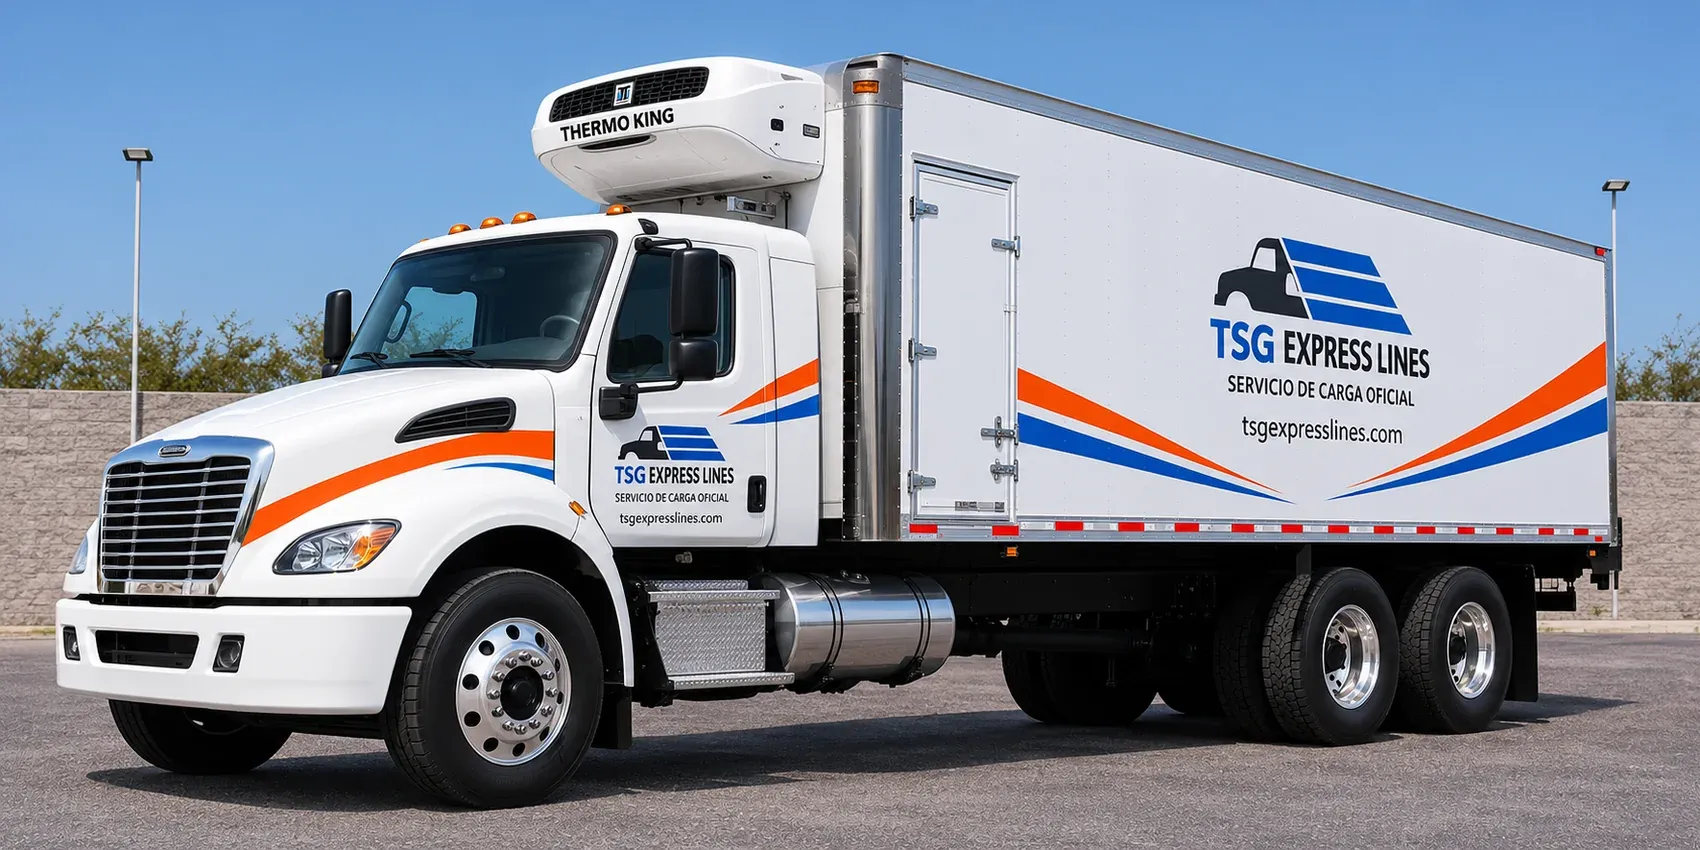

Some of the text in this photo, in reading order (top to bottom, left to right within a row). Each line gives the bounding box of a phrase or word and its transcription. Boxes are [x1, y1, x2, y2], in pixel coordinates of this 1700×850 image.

[560, 107, 674, 142] THERMO KING
[1210, 318, 1431, 379] TSG EXPRESS LINES
[1227, 374, 1416, 407] SERVICIO DE CARGA OFICIAL
[1241, 416, 1403, 445] tsgexpresslines.com
[614, 465, 735, 485] TSG EXPRESS LINES
[614, 492, 730, 503] SERVICIO DE CARGA OFICIAL
[619, 511, 723, 527] tsgexpresslines.com
